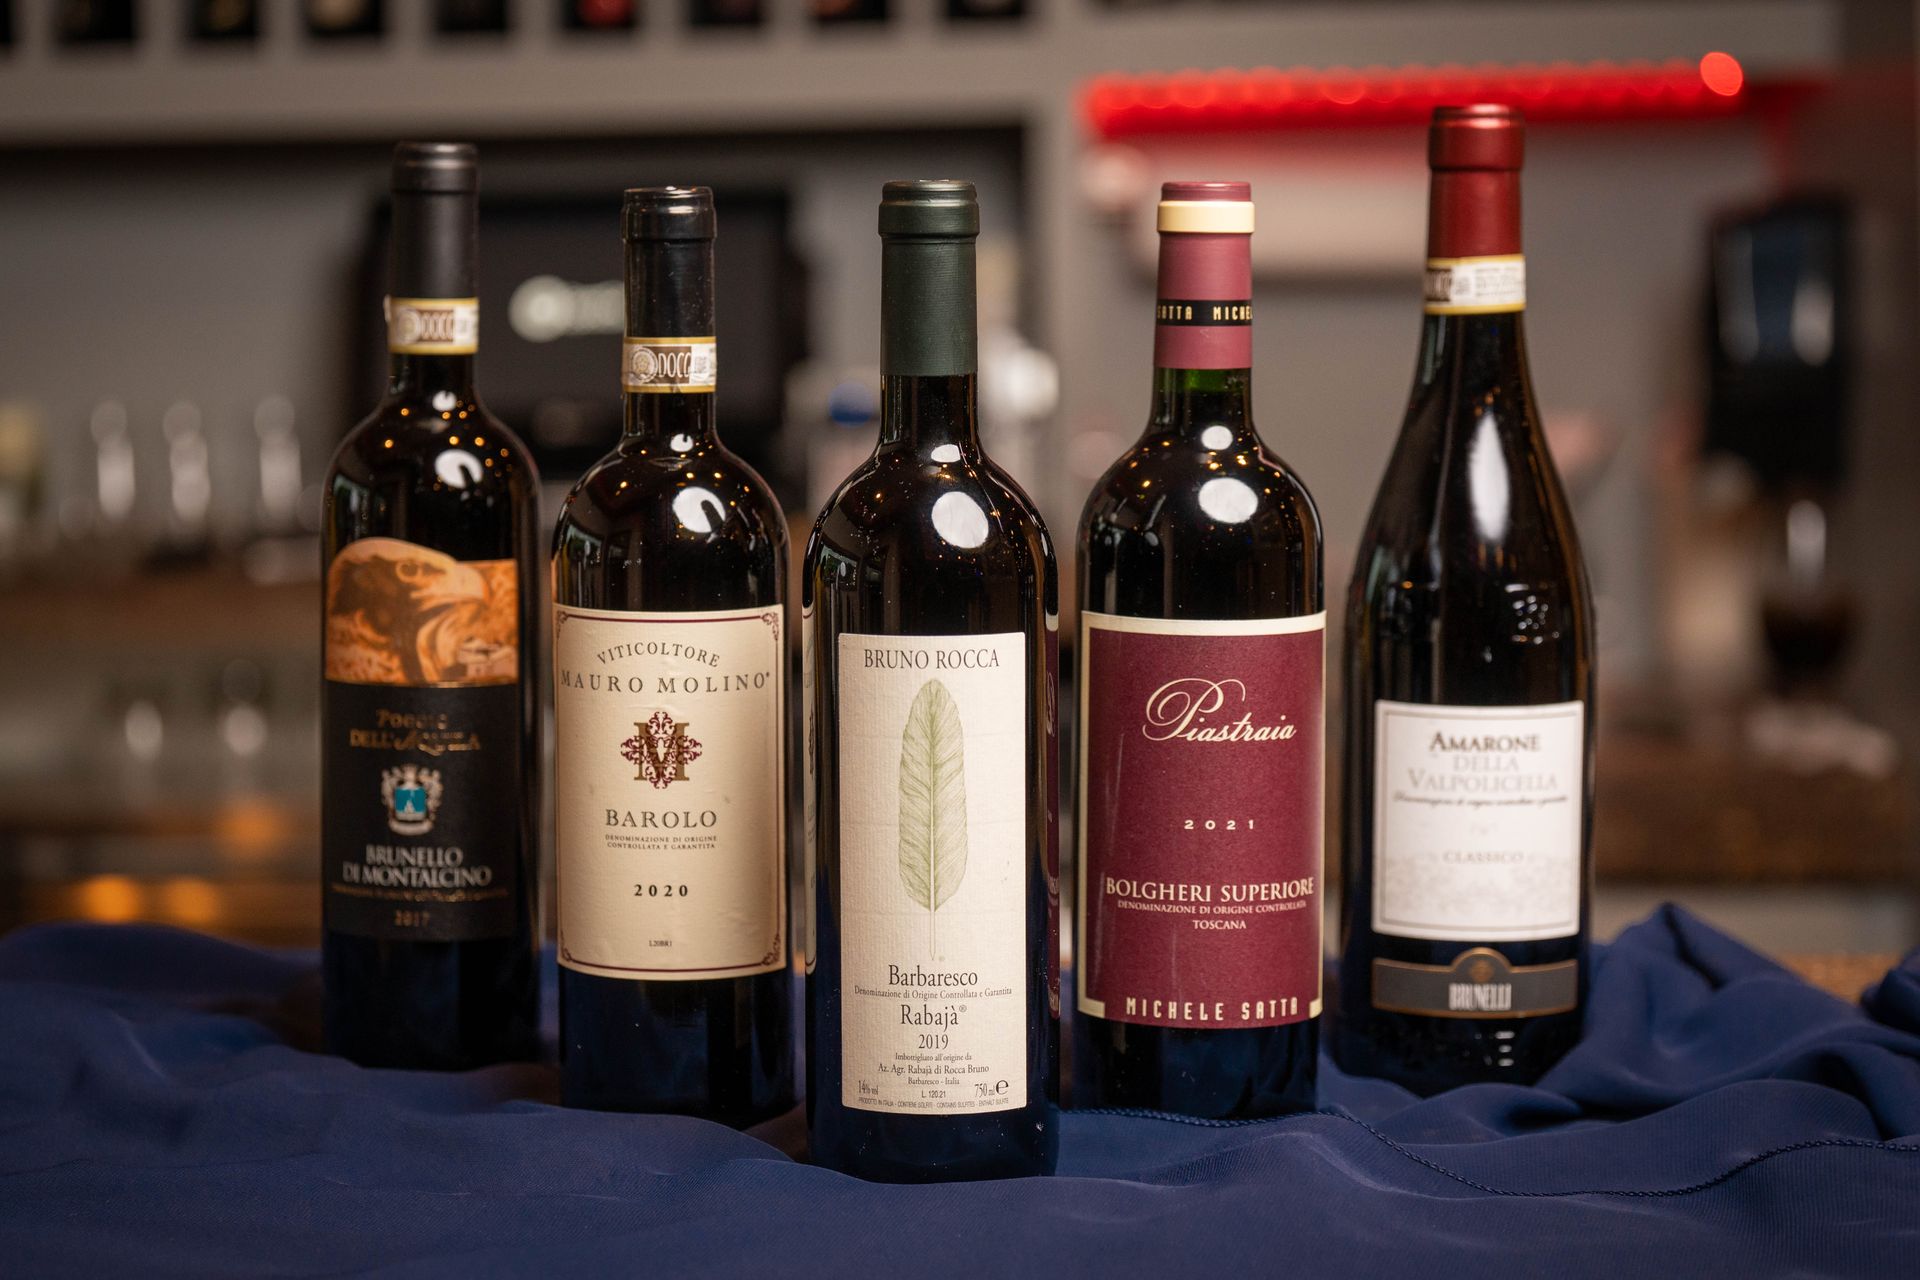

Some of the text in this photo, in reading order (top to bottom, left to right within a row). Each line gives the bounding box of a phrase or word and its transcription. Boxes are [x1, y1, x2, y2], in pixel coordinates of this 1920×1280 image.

[597, 641, 721, 668] VITICOLTORE
[864, 648, 1000, 669] BRUNO ROCCA
[561, 669, 643, 694] MAURO
[1142, 677, 1297, 742] Piastraia
[1453, 755, 1520, 773] DELLA
[605, 808, 718, 829] BAROLO
[1184, 819, 1254, 831] 2021
[605, 833, 670, 843] DENOMINAZIONE
[685, 834, 718, 843] ORIGINE
[607, 841, 661, 851] CONTROLLATA
[671, 842, 716, 850] GARANTITA
[366, 843, 464, 868] BRUNELLO
[342, 861, 493, 889] DI MONTALCINO
[634, 883, 689, 897] 2020
[1106, 876, 1315, 903] BOLGHERI SUPERIORE
[1117, 899, 1197, 915] DENOMINAZIONE
[1199, 905, 1211, 915] DI
[1213, 905, 1254, 915] ORIGINE
[1192, 919, 1247, 931] TOSCANA
[888, 964, 978, 987] Barbaresco
[854, 984, 902, 999] Denominazione
[903, 989, 911, 999] di
[912, 989, 939, 1002] Origine
[940, 988, 978, 999] Controllata
[984, 986, 1013, 998] Garantita
[1126, 996, 1299, 1021] MICHELE SATTA
[918, 1033, 949, 1050] 2019
[895, 1051, 933, 1063] Imbottigliato
[964, 1053, 973, 1061] da
[878, 1063, 890, 1073] Az.
[891, 1063, 907, 1076] Agr.
[934, 1065, 943, 1075] di
[944, 1065, 966, 1075] Rocca
[968, 1063, 990, 1073] Bruno
[907, 1076, 939, 1085] Barbaresco
[945, 1076, 960, 1085] Italia
[974, 1082, 988, 1098] 750
